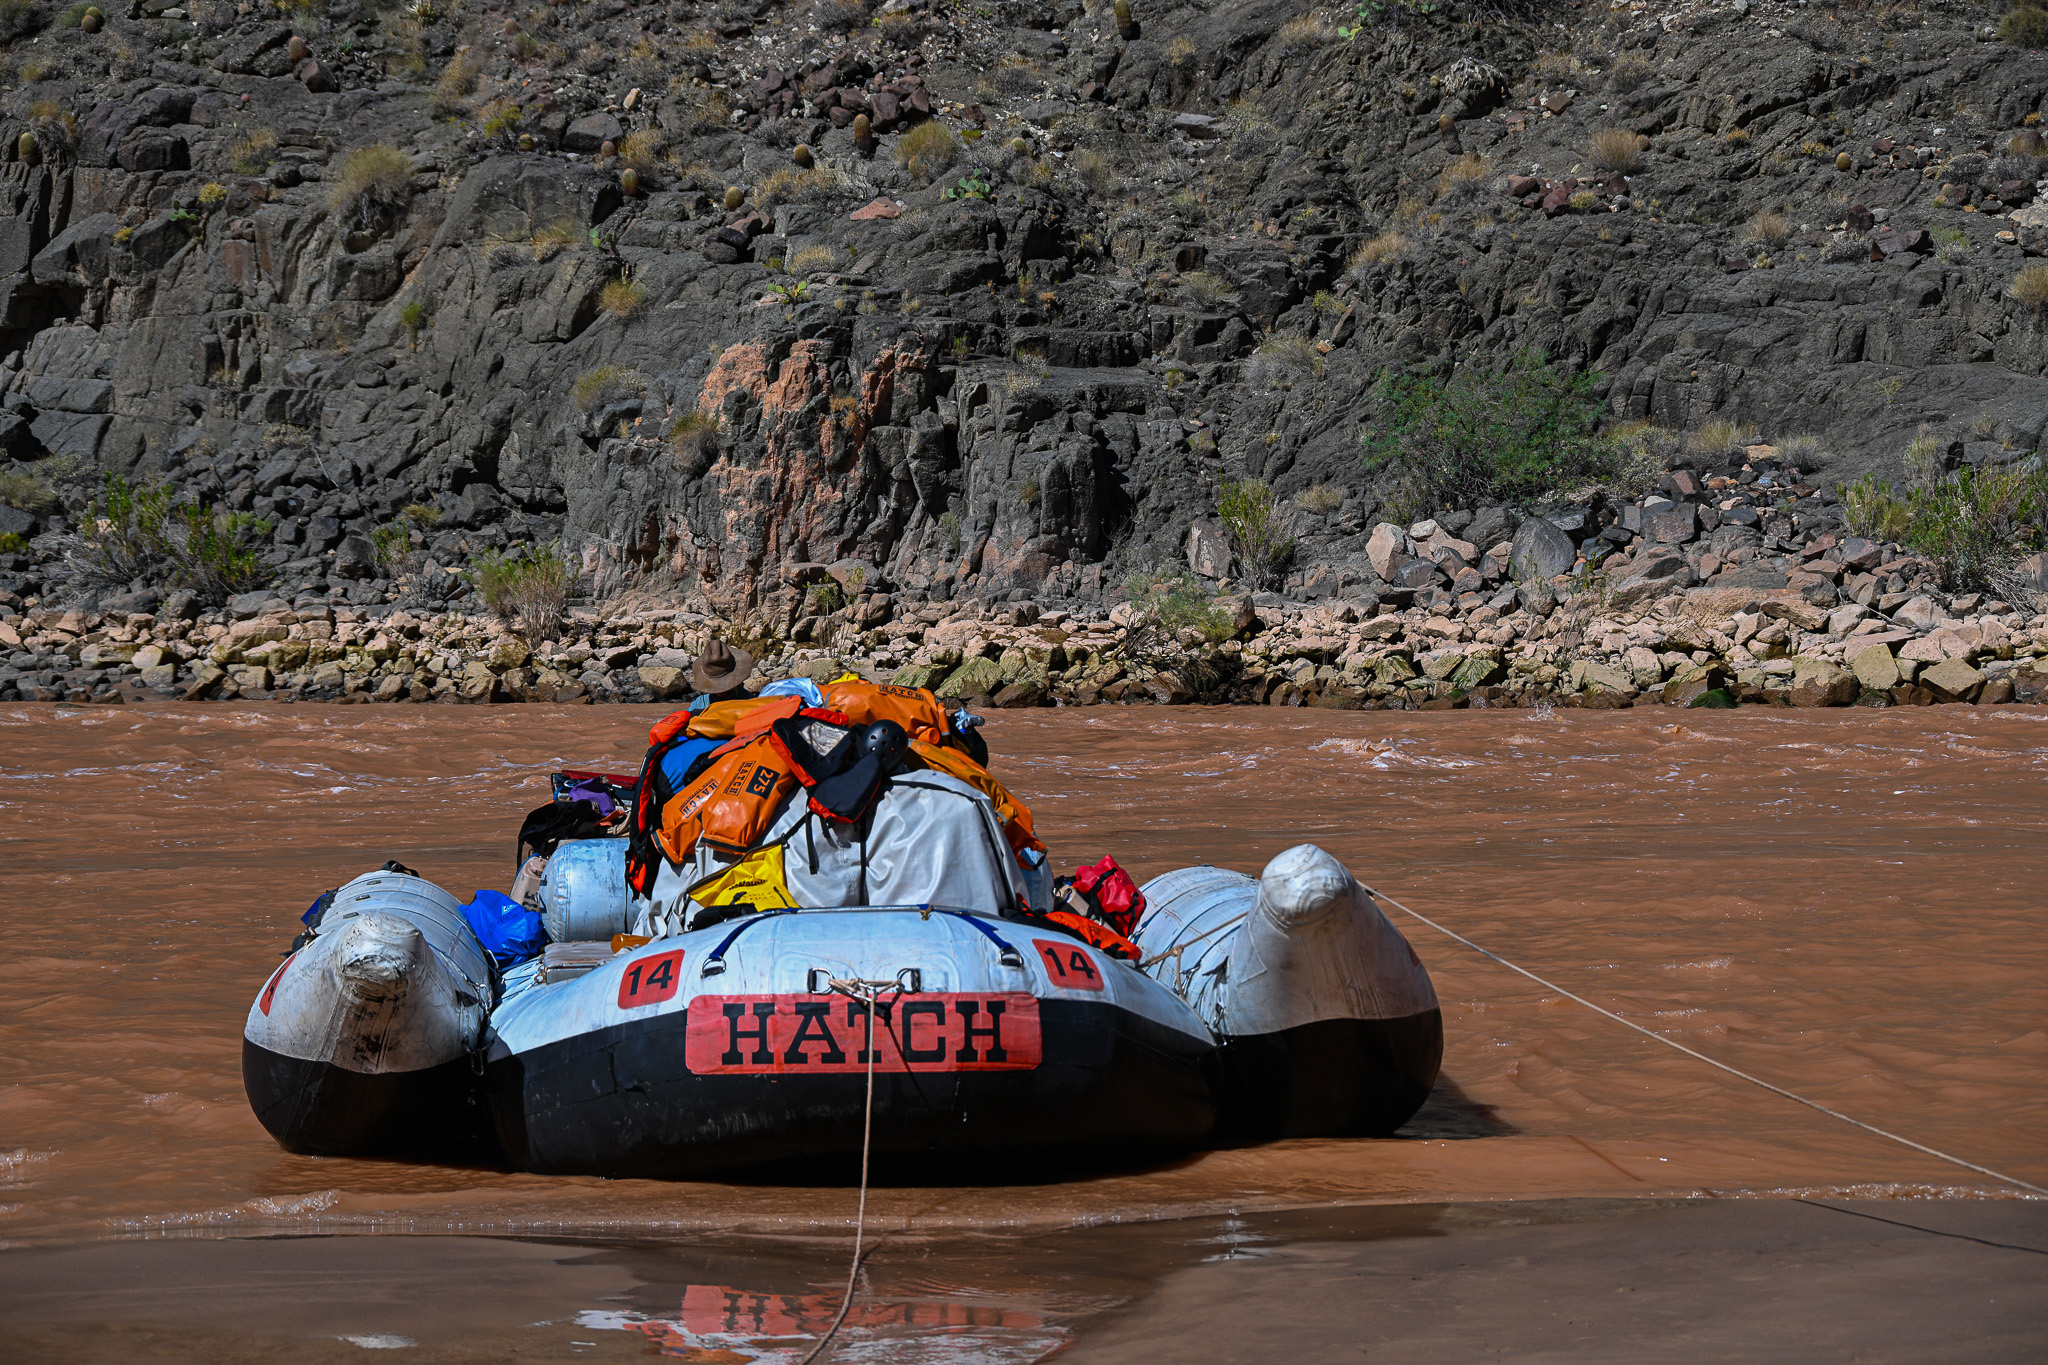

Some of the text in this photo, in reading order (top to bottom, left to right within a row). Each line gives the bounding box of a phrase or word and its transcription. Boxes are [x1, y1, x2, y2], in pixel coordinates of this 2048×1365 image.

[882, 685, 923, 698] HATCH
[728, 761, 753, 796] HATCH
[753, 769, 774, 793] 275
[682, 781, 718, 815] HATCH
[628, 959, 673, 996] 14
[1044, 947, 1095, 979] 14
[721, 1001, 1007, 1065] HATCH
